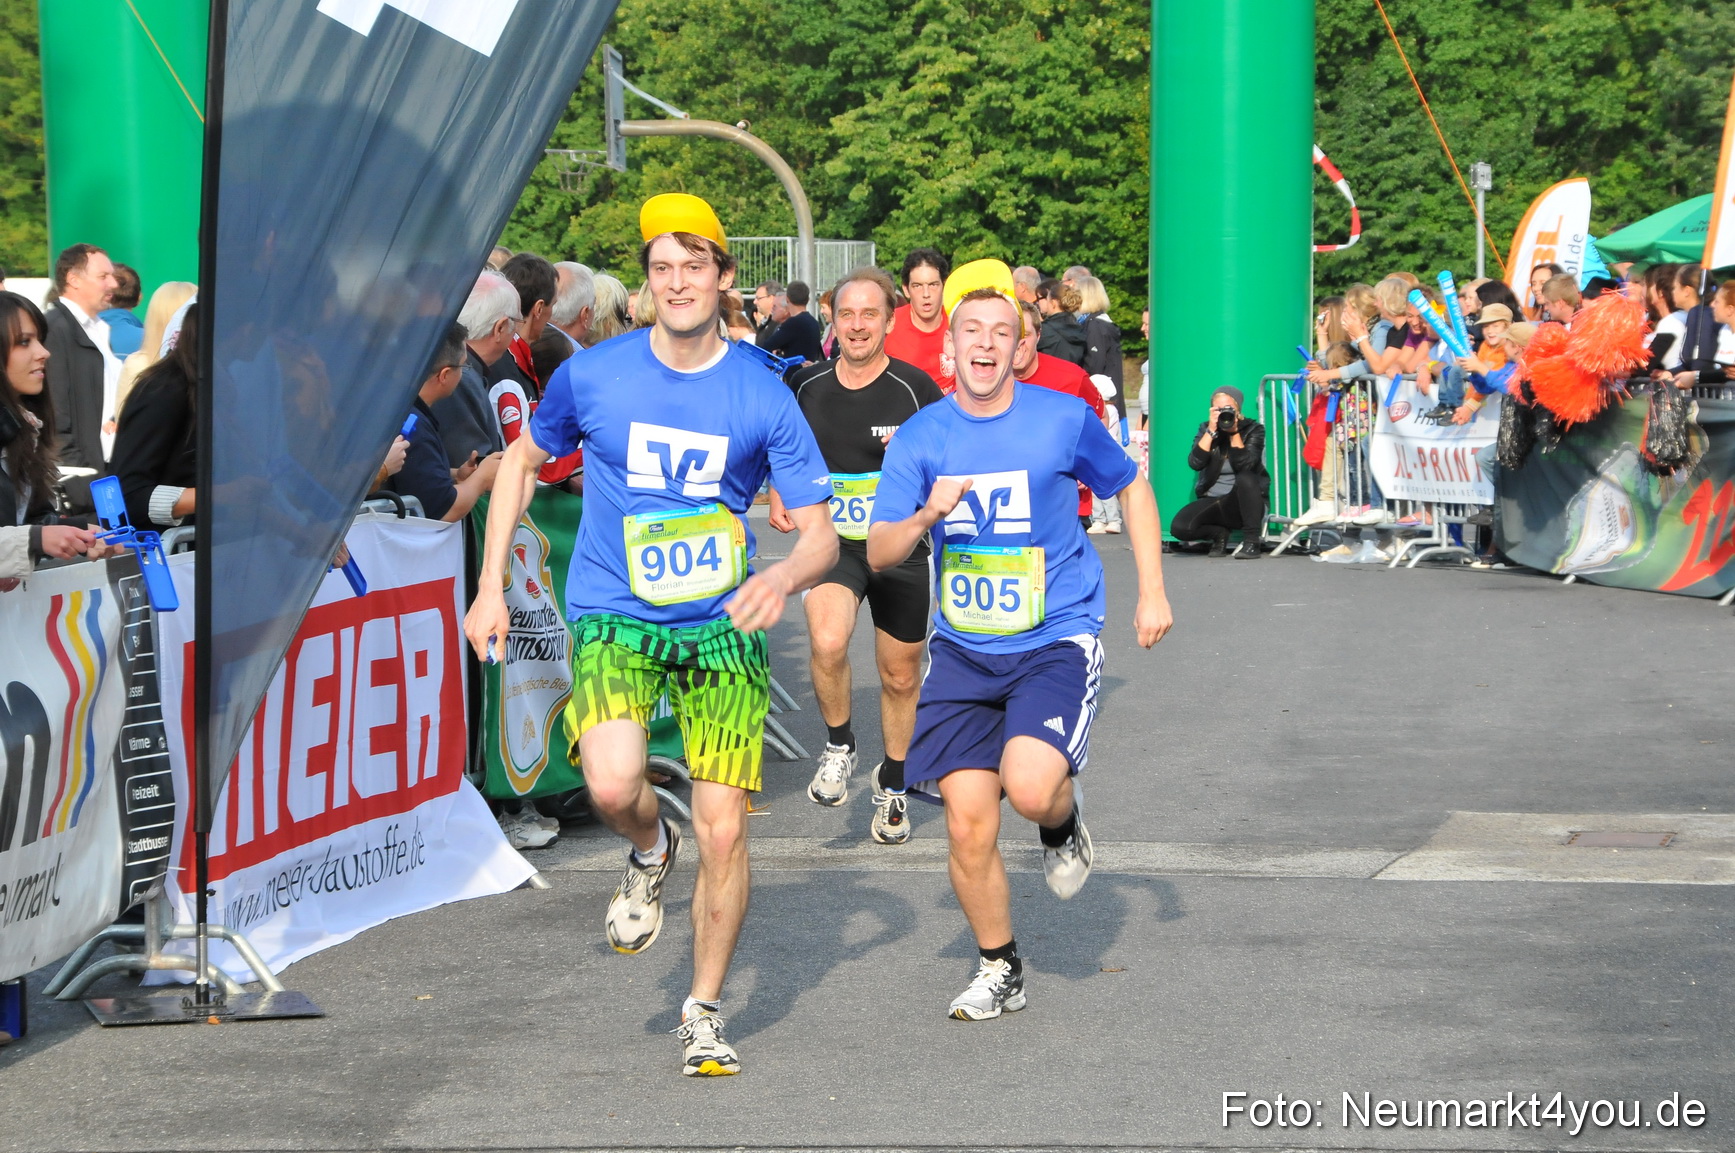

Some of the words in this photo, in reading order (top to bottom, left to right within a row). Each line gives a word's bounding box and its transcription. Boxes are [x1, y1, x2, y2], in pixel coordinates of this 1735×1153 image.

[641, 535, 722, 582] 904
[651, 580, 684, 592] Florian
[950, 574, 1021, 613] 905
[963, 610, 993, 621] Michael
